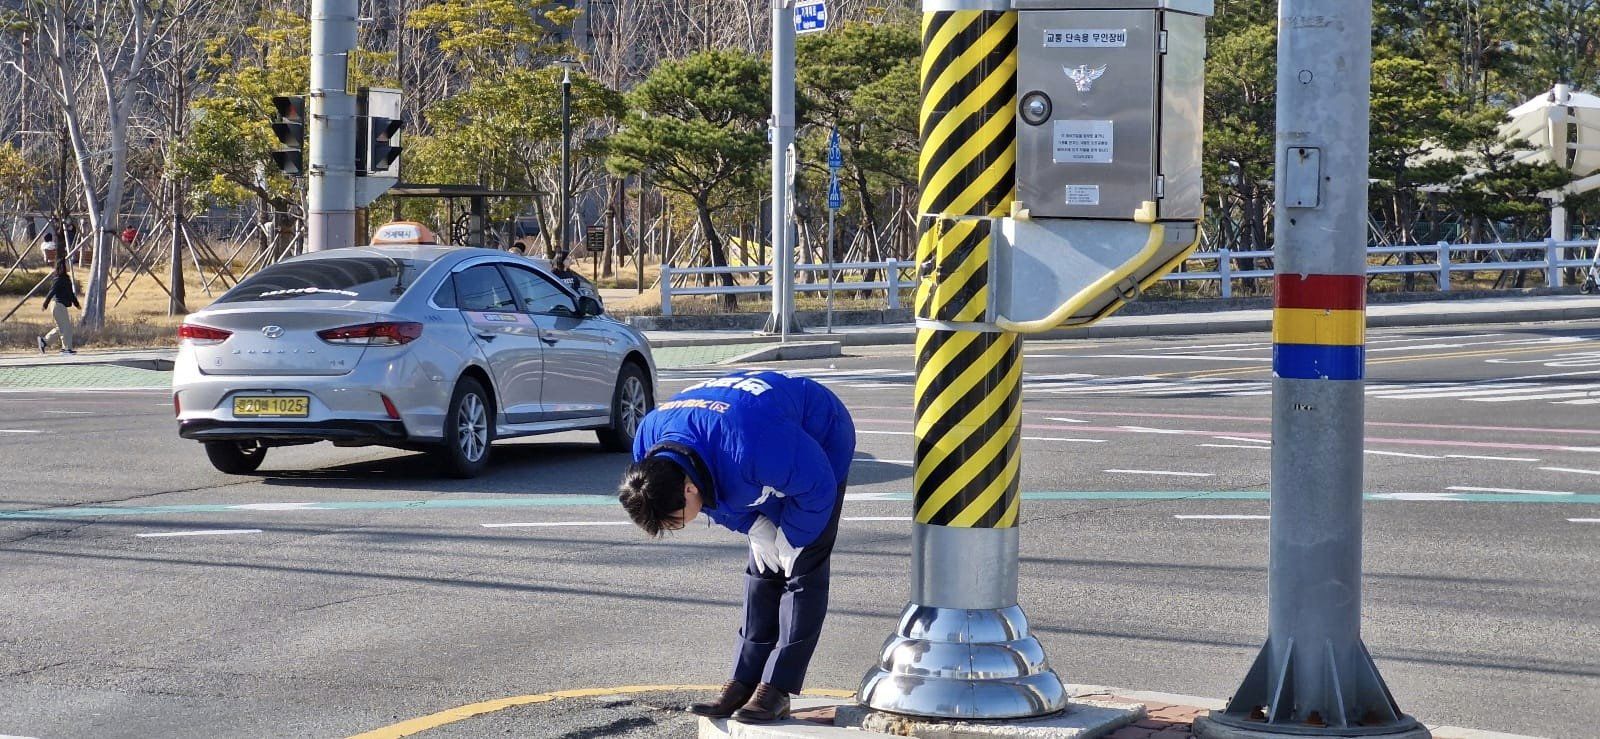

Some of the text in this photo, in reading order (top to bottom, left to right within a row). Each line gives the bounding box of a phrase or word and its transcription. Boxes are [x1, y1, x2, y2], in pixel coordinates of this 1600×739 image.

[1047, 33, 1125, 43] 교통 단속용 무인장비
[272, 399, 303, 412] 1025
